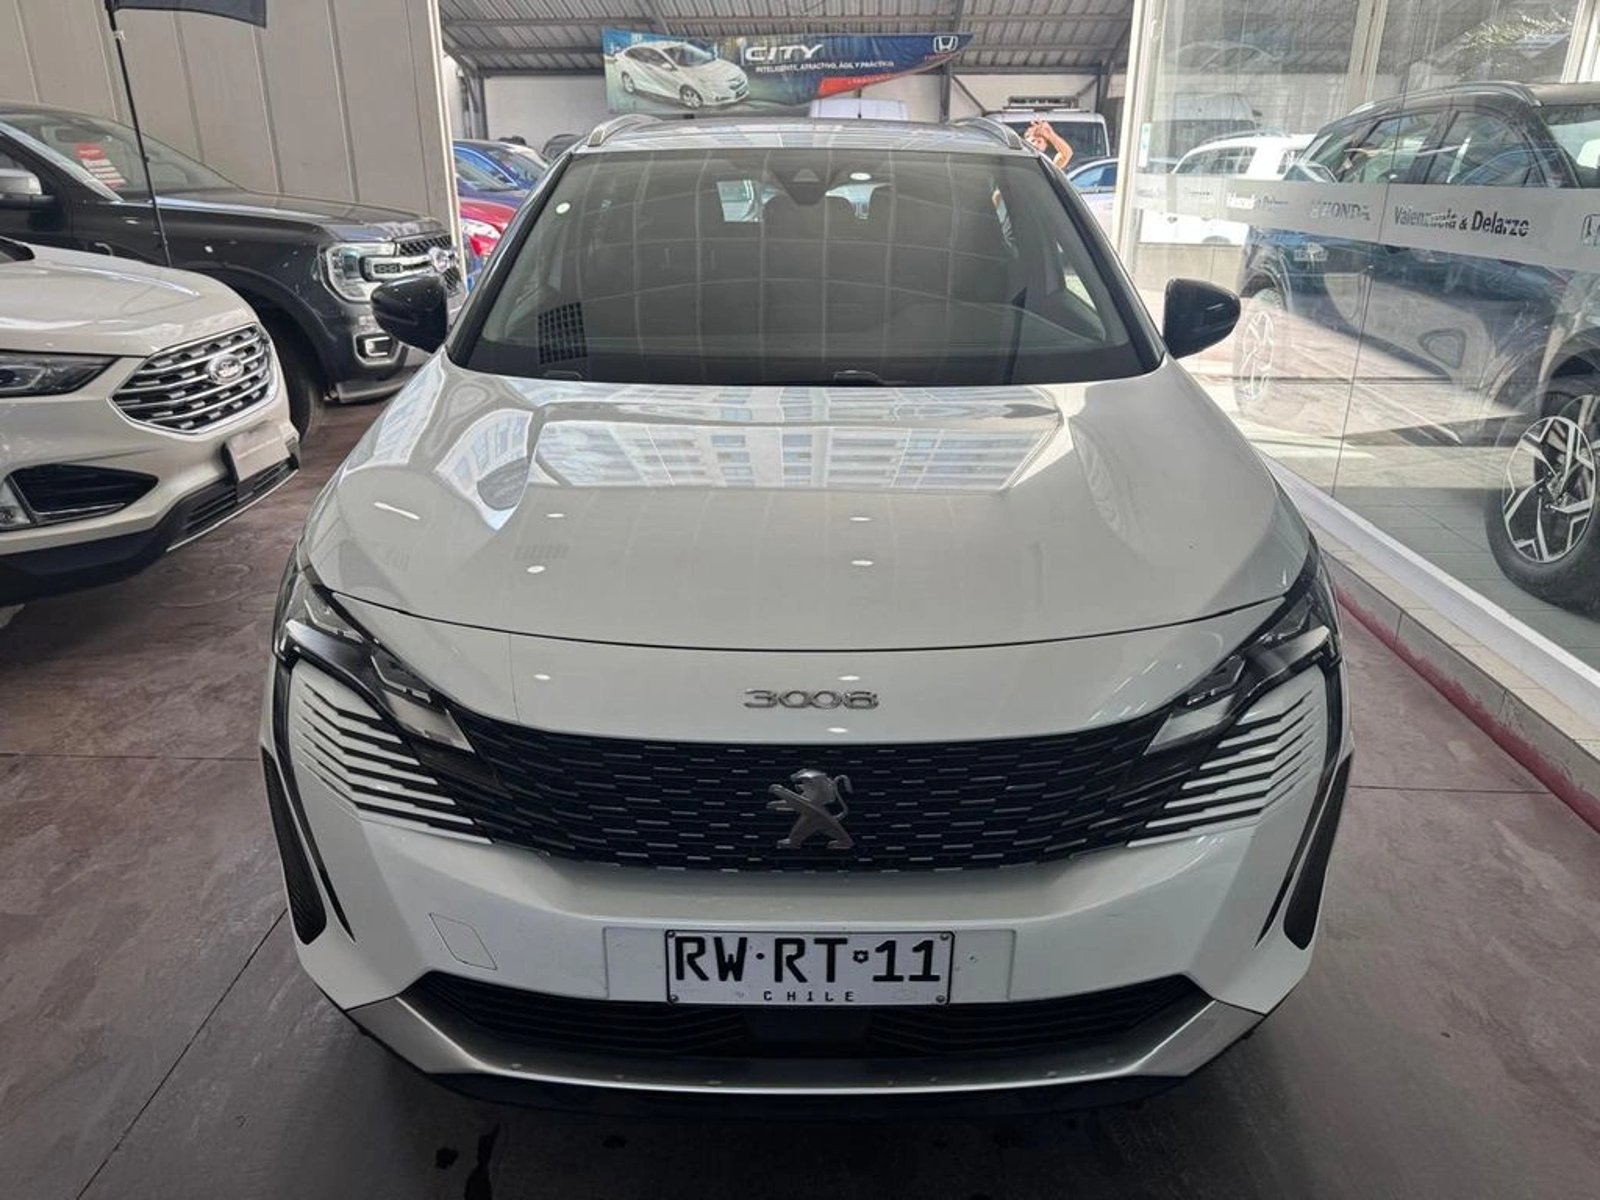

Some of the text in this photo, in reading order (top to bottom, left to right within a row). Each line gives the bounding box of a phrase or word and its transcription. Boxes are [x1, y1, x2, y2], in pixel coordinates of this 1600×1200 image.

[745, 44, 824, 61] CITY
[743, 689, 879, 710] 3008
[763, 990, 855, 1002] CHILE
